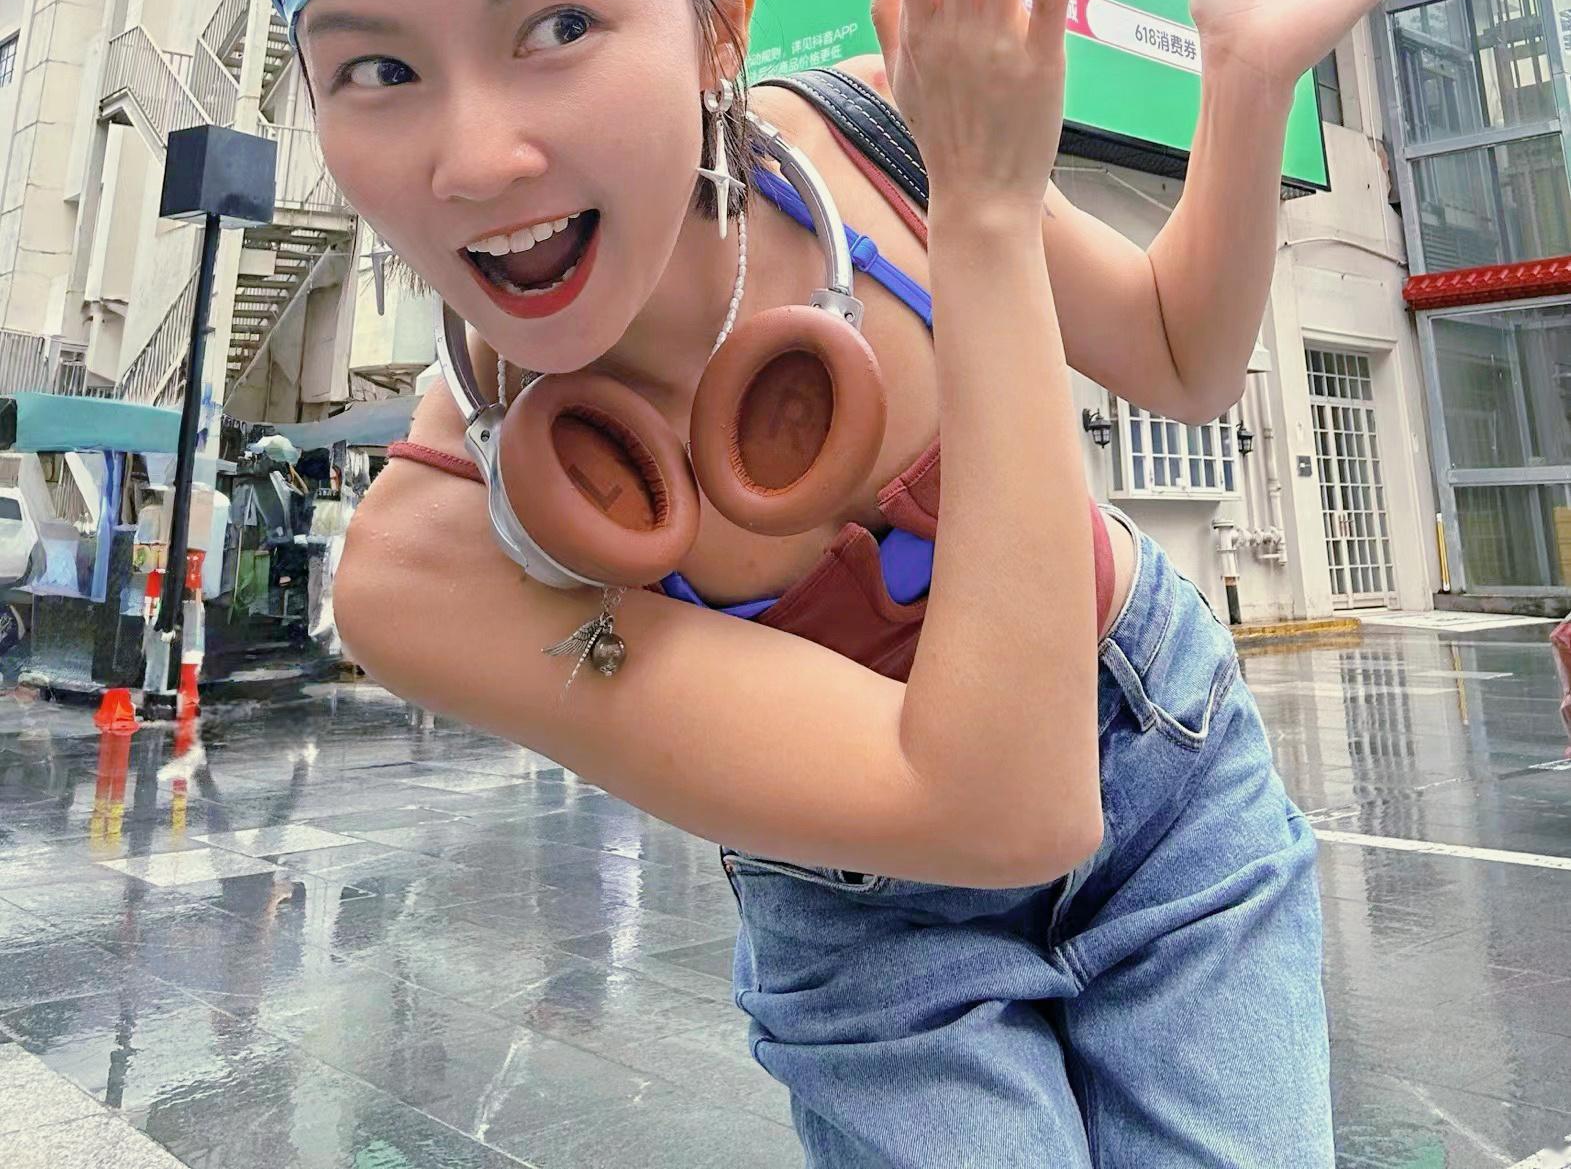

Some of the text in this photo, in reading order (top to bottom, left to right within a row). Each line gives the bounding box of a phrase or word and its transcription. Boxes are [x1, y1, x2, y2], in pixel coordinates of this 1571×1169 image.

[1135, 24, 1197, 60] 618消费券
[568, 463, 625, 512] L
